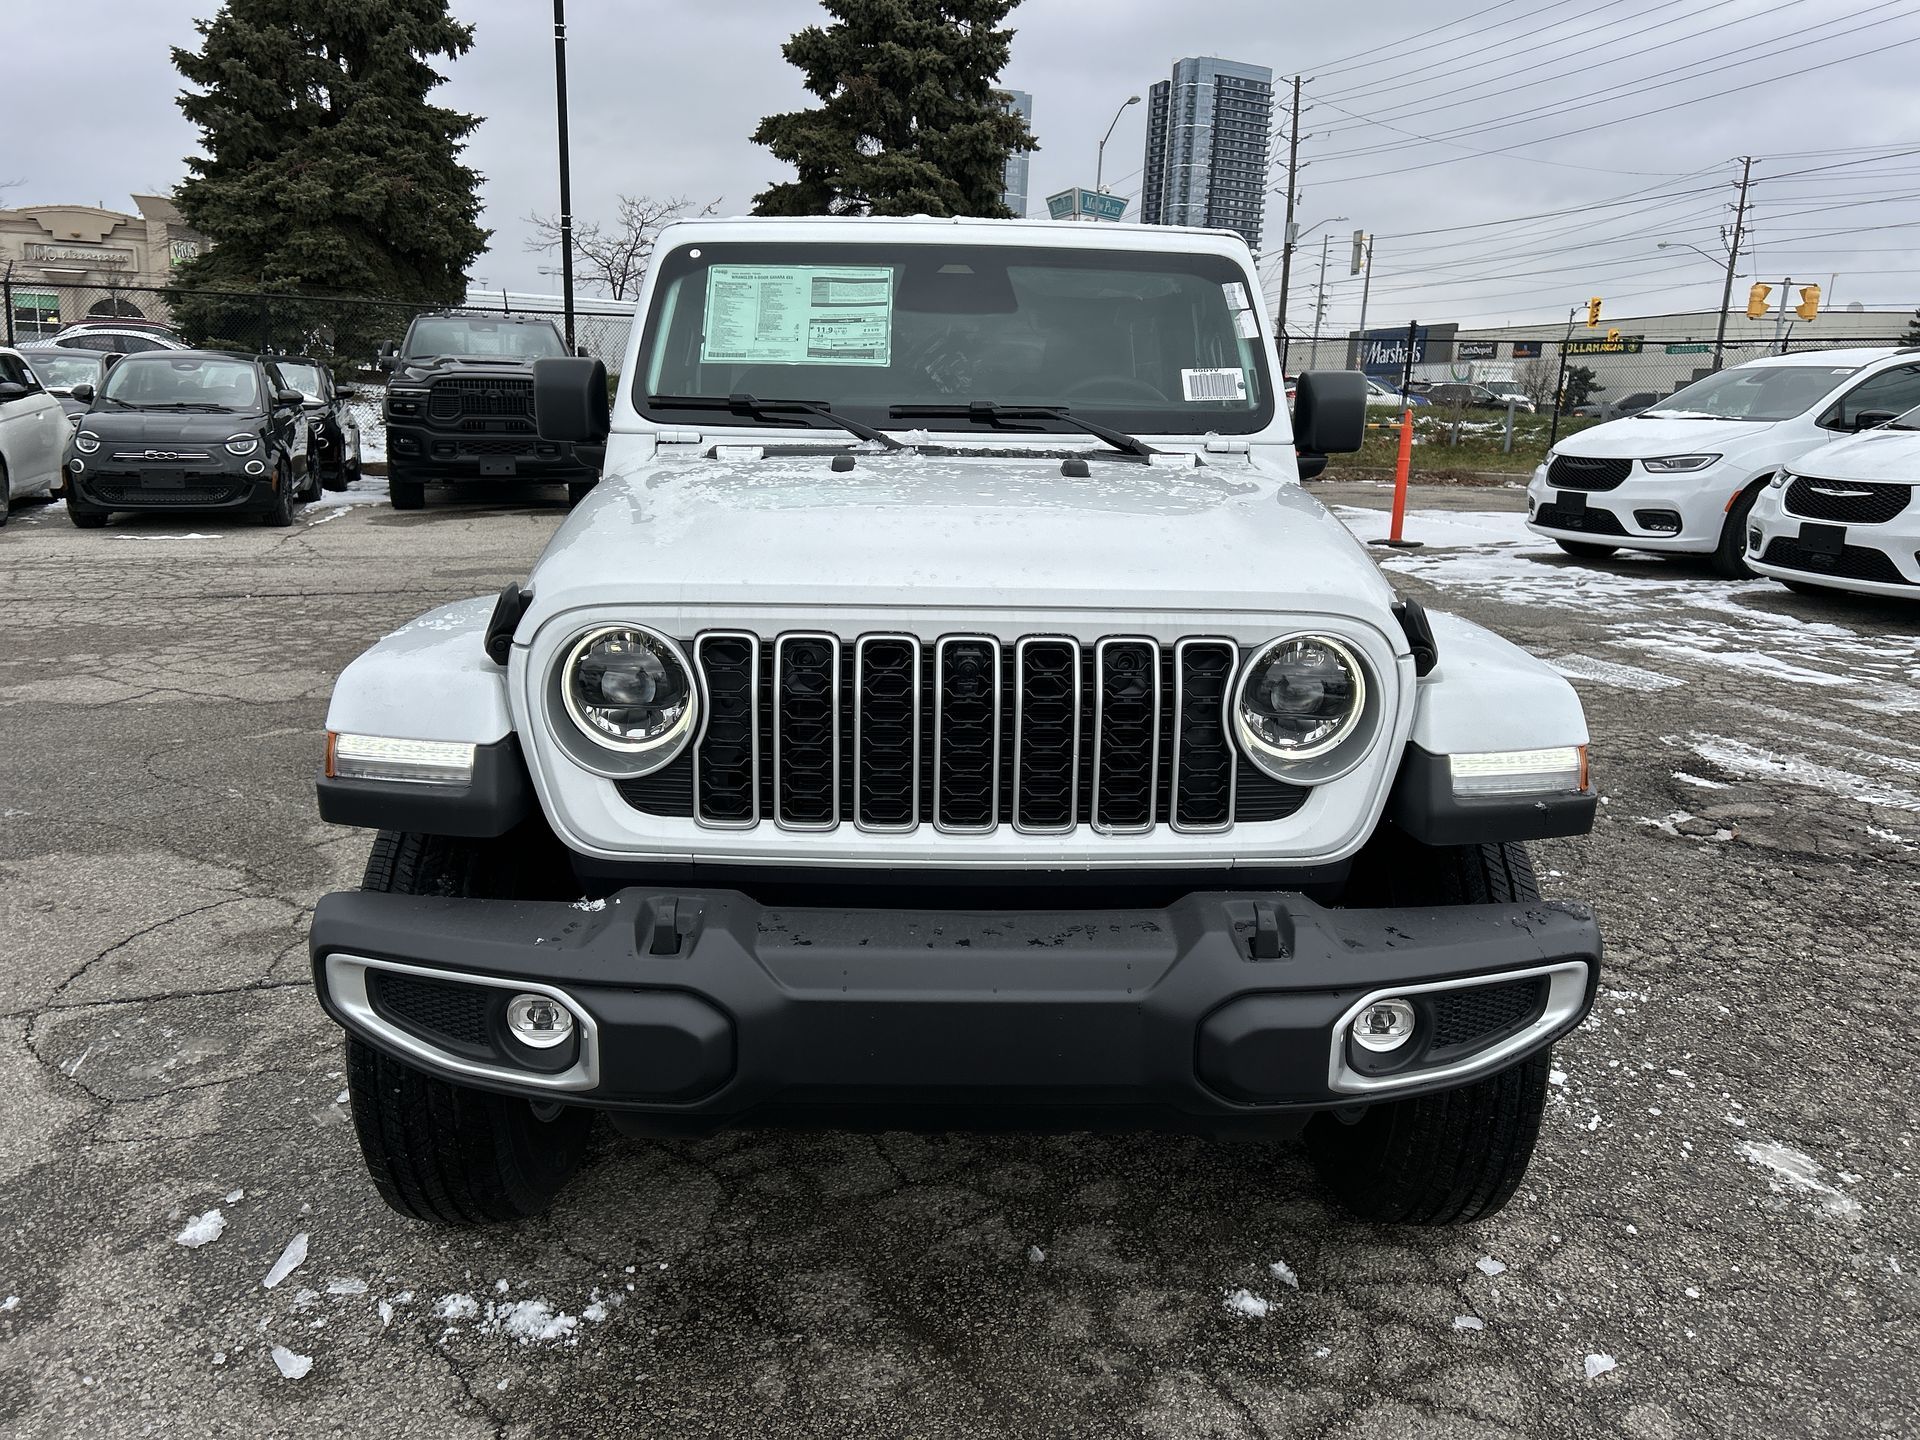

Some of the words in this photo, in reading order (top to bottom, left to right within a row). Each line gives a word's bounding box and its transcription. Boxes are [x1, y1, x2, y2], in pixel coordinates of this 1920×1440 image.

[1366, 341, 1421, 364] Marshals
[461, 389, 526, 397] RAM
[144, 450, 177, 459] 500
